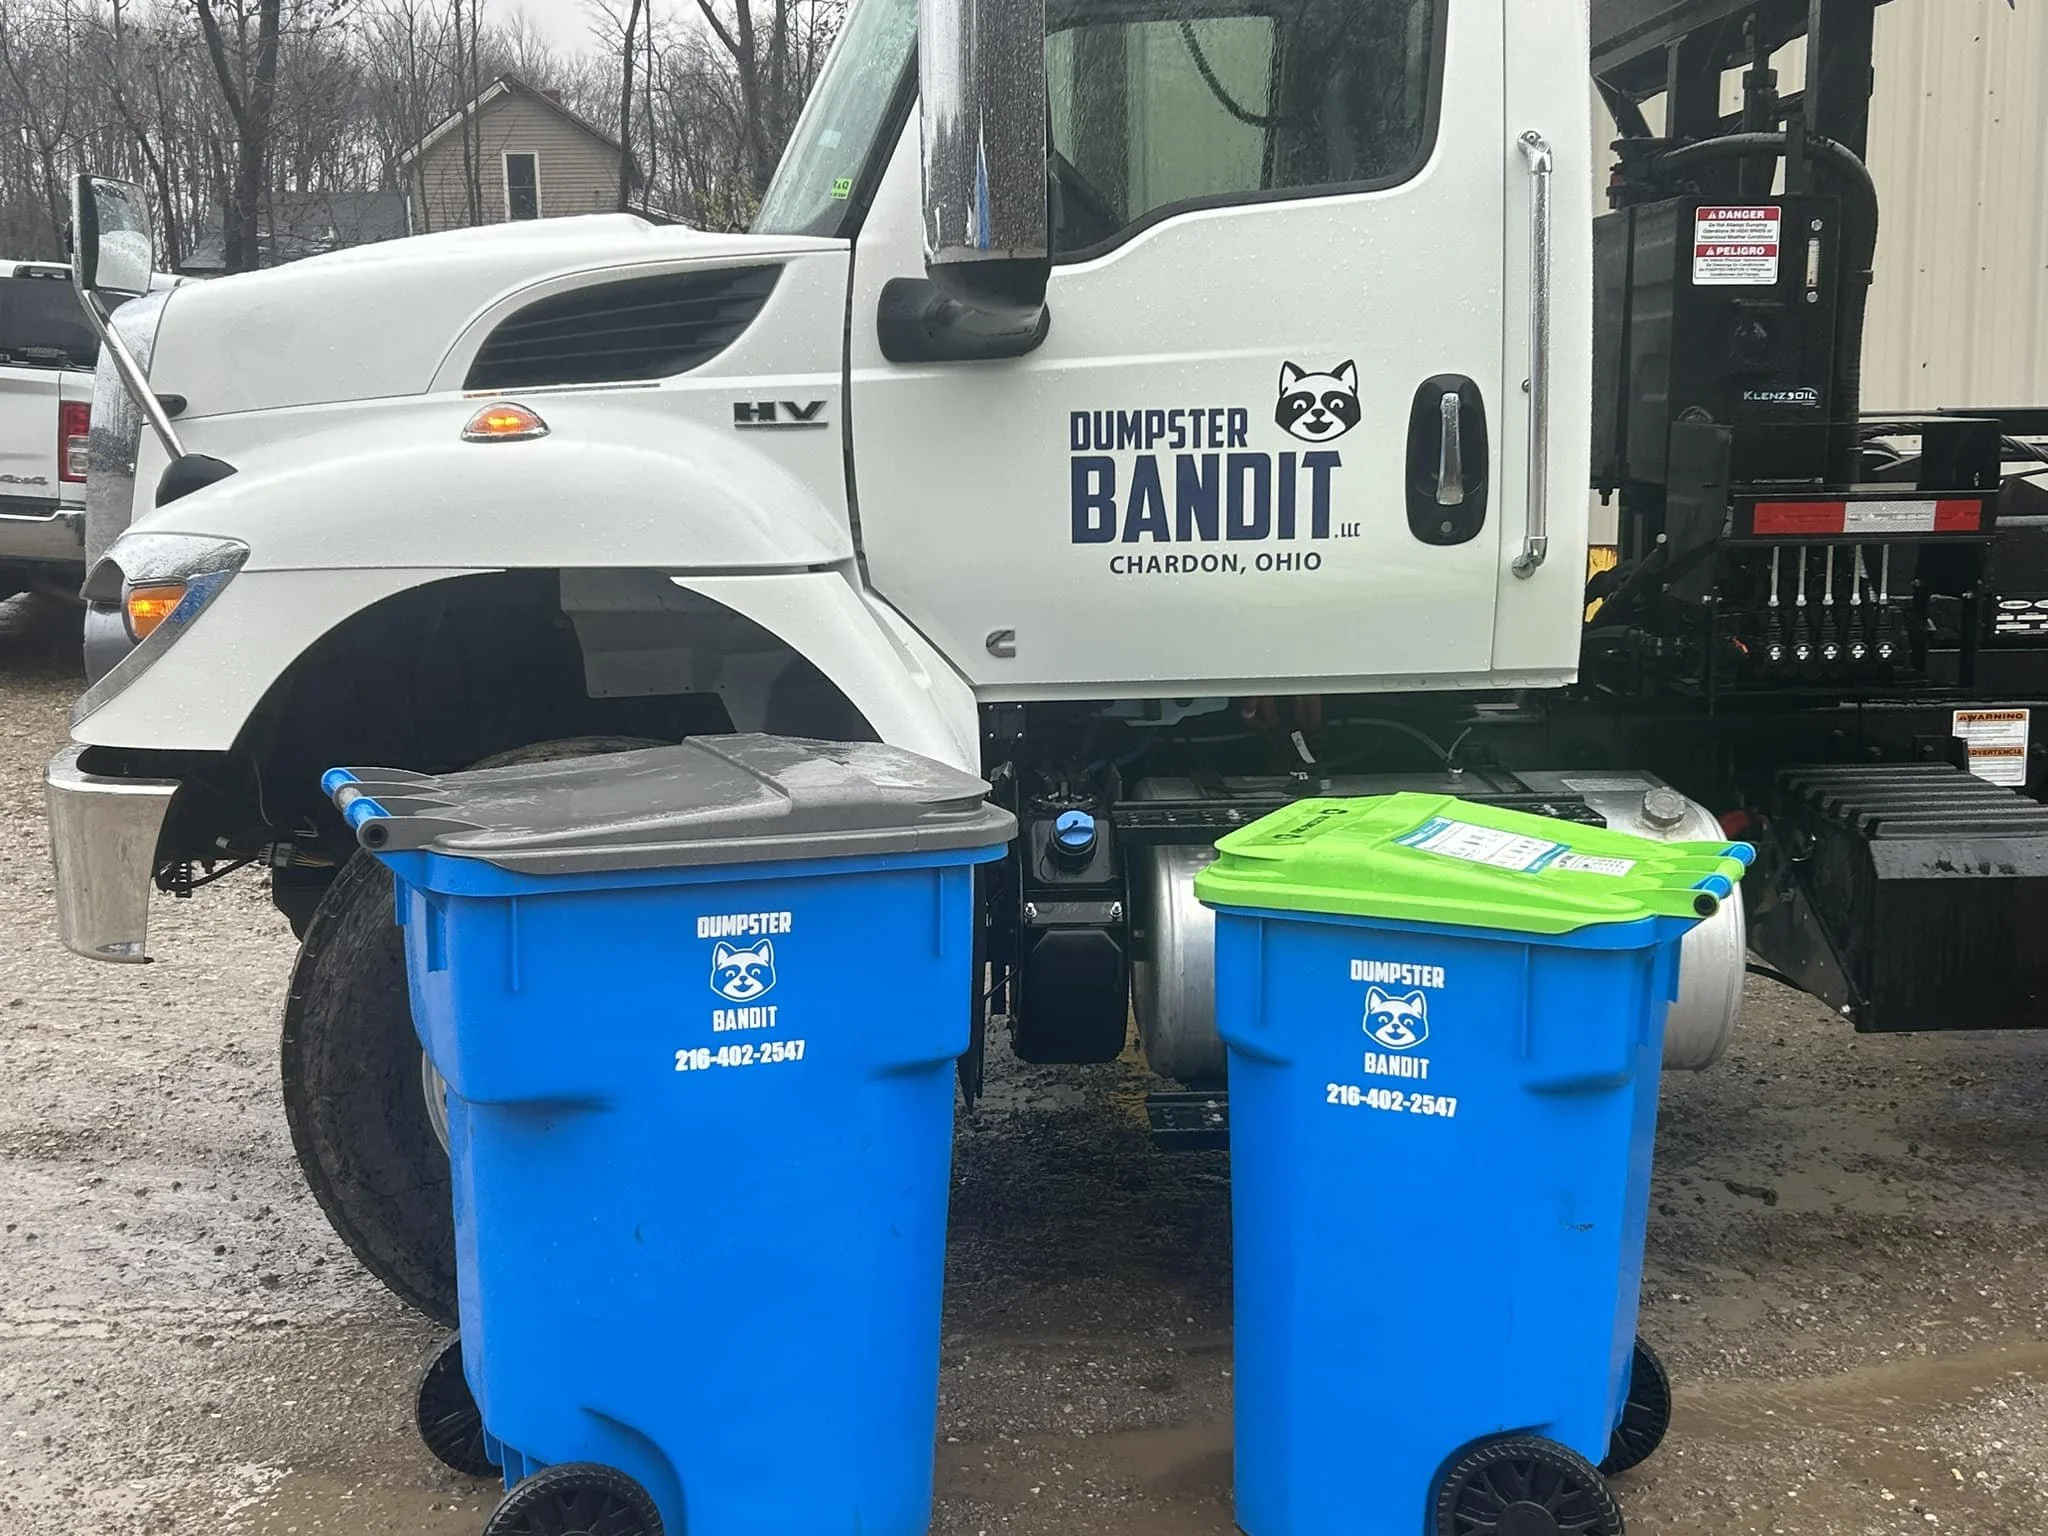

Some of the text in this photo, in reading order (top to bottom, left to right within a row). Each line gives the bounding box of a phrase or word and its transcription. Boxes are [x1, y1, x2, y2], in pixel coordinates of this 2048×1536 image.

[1718, 210, 1765, 219] DANGER
[1716, 246, 1766, 256] PELIGRO
[733, 400, 827, 422] HV
[1070, 407, 1249, 451] DUMPSTER
[1071, 450, 1343, 544] BANDIT
[1109, 551, 1322, 575] CHARDON, OHIO
[1966, 712, 2024, 721] WARNING
[697, 911, 792, 939] DUMPSTER
[1350, 959, 1445, 989] DUMPSTER
[712, 1005, 778, 1032] BANDIT
[675, 1039, 806, 1072] 216-402-2547
[1364, 1052, 1430, 1079] BANDIT
[1326, 1083, 1457, 1118] 216-402-2547
